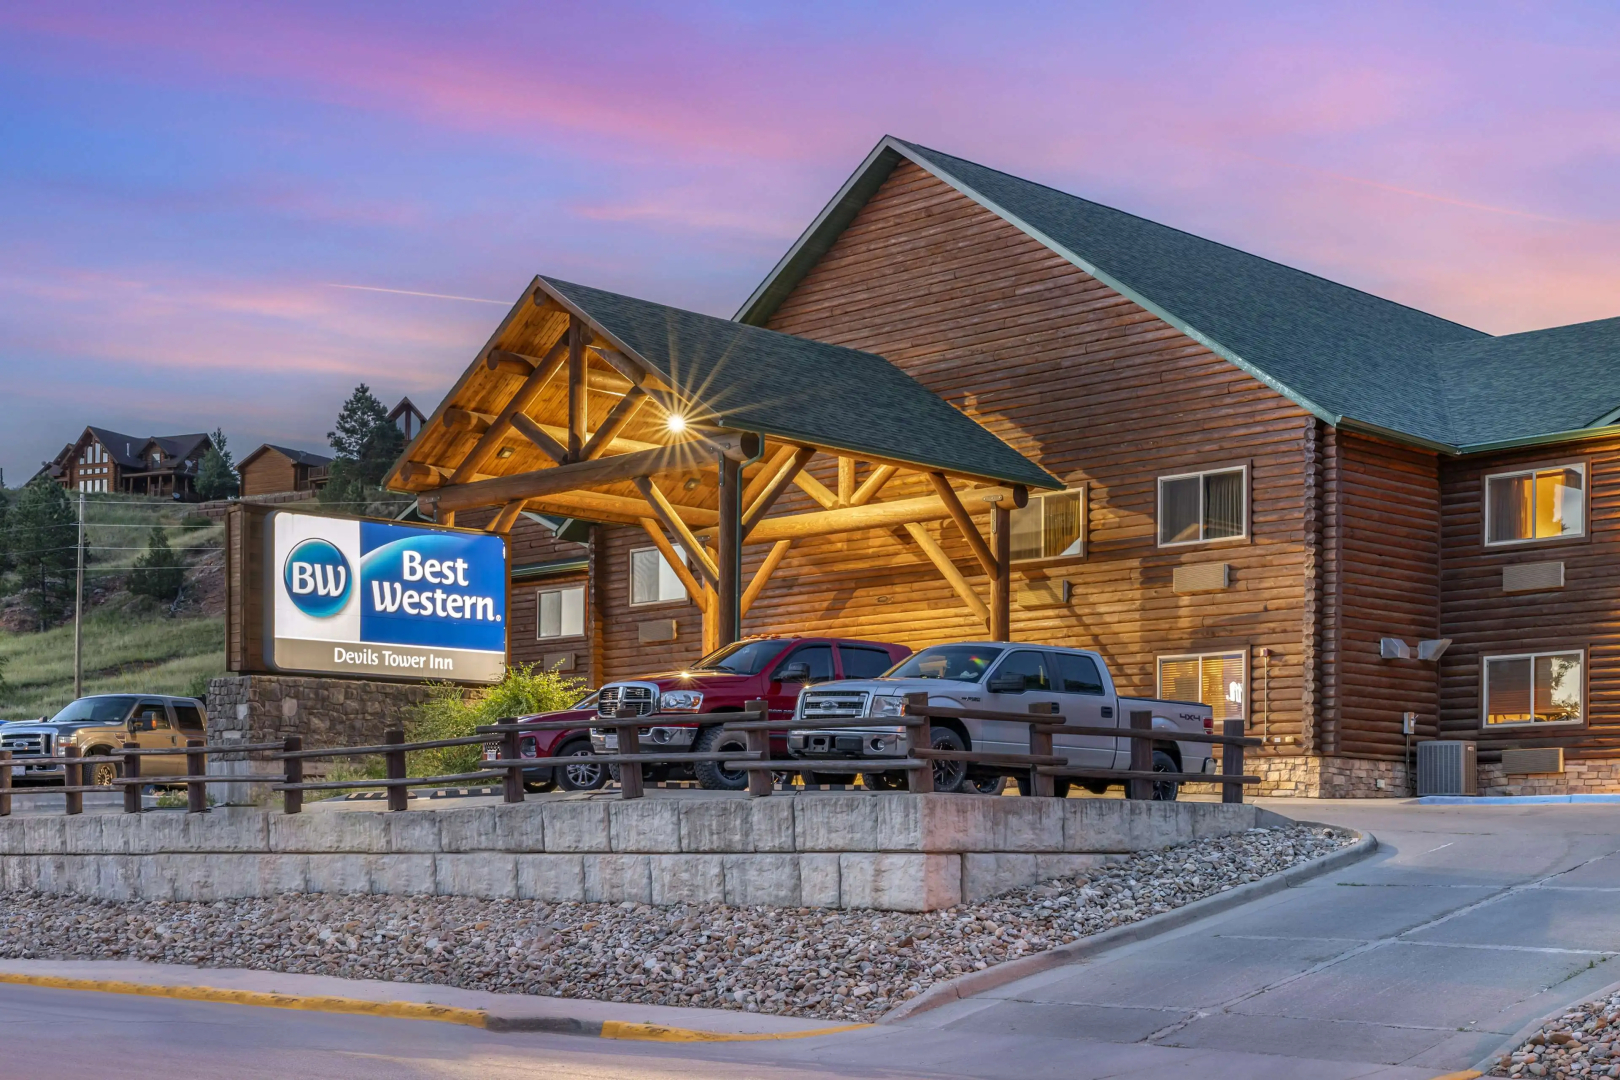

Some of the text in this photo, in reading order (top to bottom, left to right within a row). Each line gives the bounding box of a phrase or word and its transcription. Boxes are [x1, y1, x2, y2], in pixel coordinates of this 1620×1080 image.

[292, 561, 346, 598] BW
[402, 550, 469, 587] Best
[333, 647, 454, 670] Devils Tower Inn
